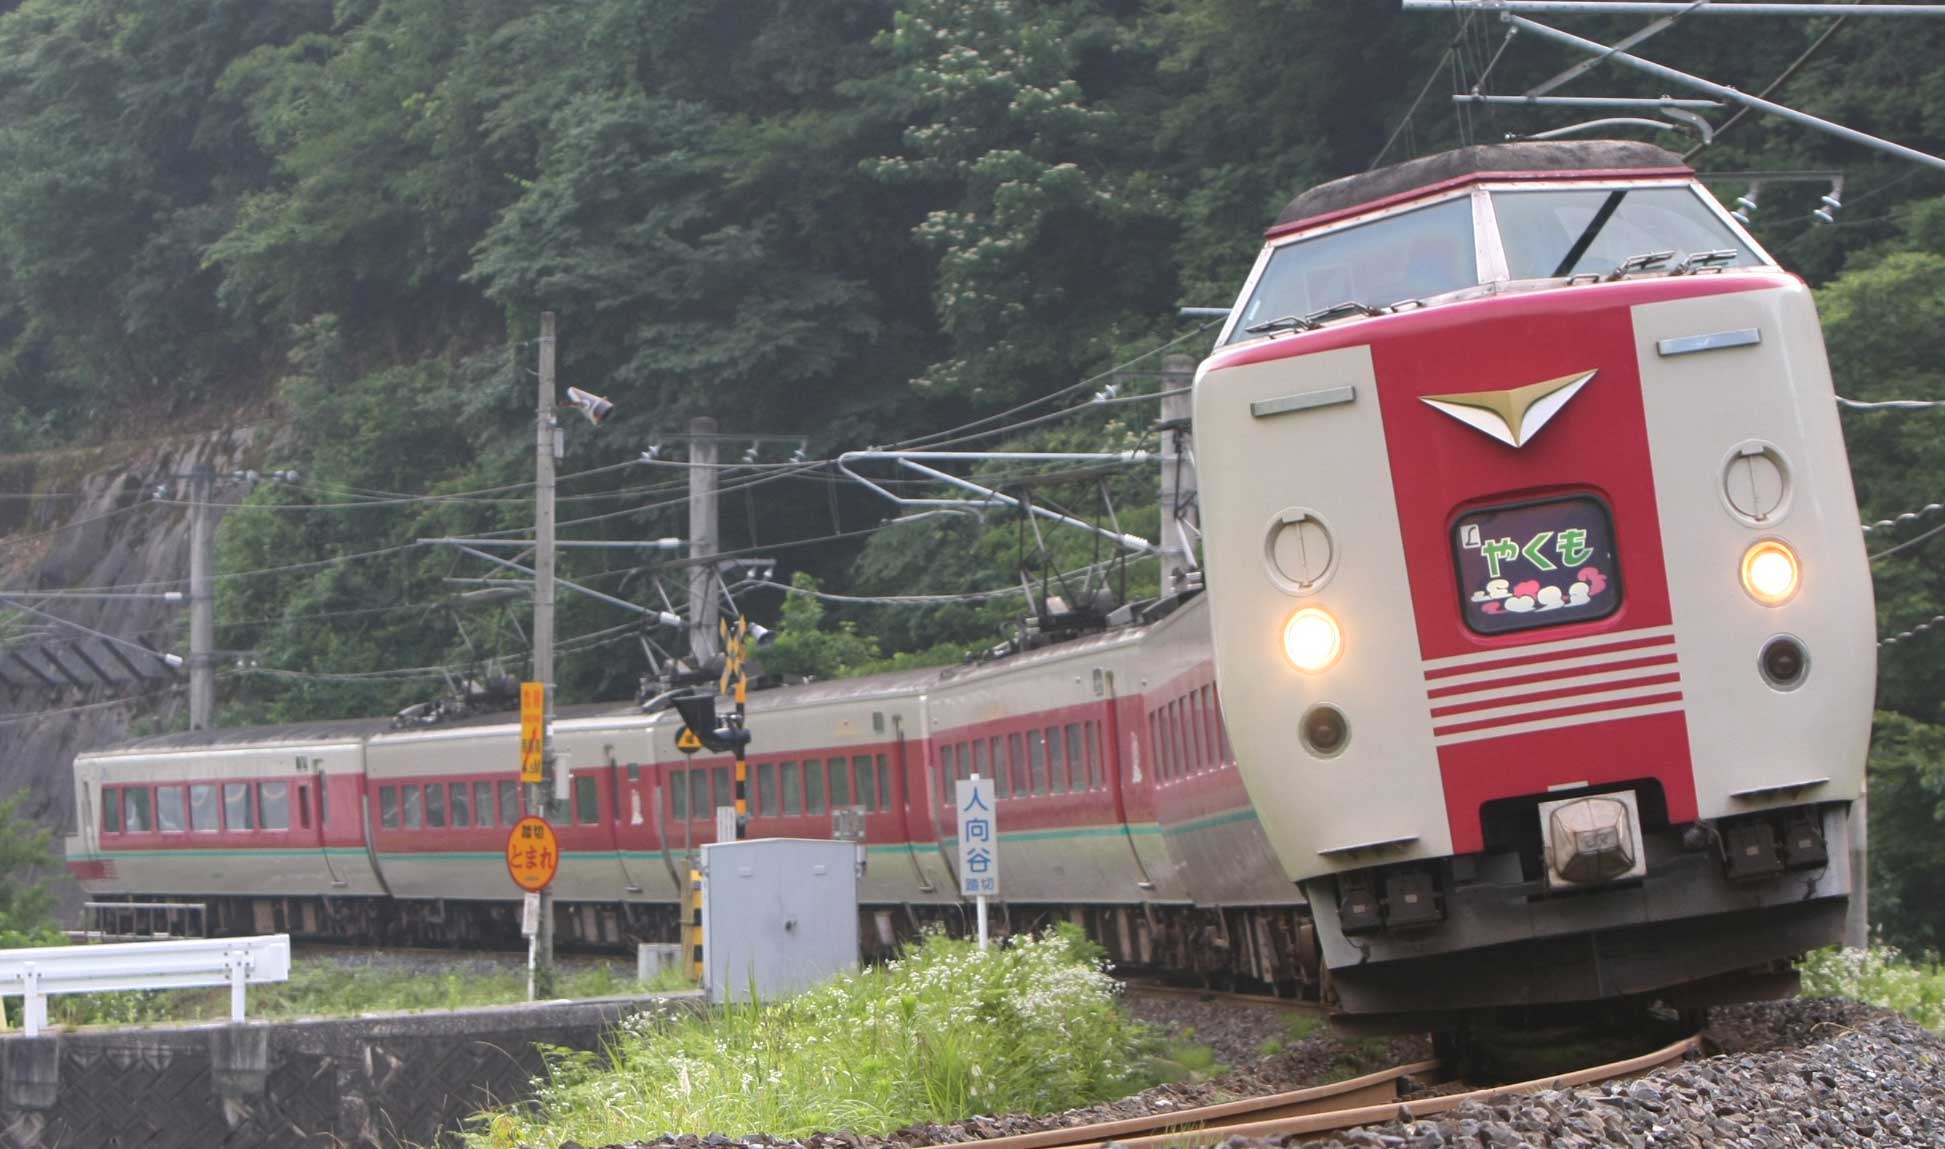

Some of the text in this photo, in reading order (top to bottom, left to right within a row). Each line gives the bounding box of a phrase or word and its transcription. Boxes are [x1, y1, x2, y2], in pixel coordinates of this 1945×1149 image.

[1481, 528, 1594, 578] やくも
[964, 786, 991, 873] 人向谷
[511, 845, 554, 869] とまれ
